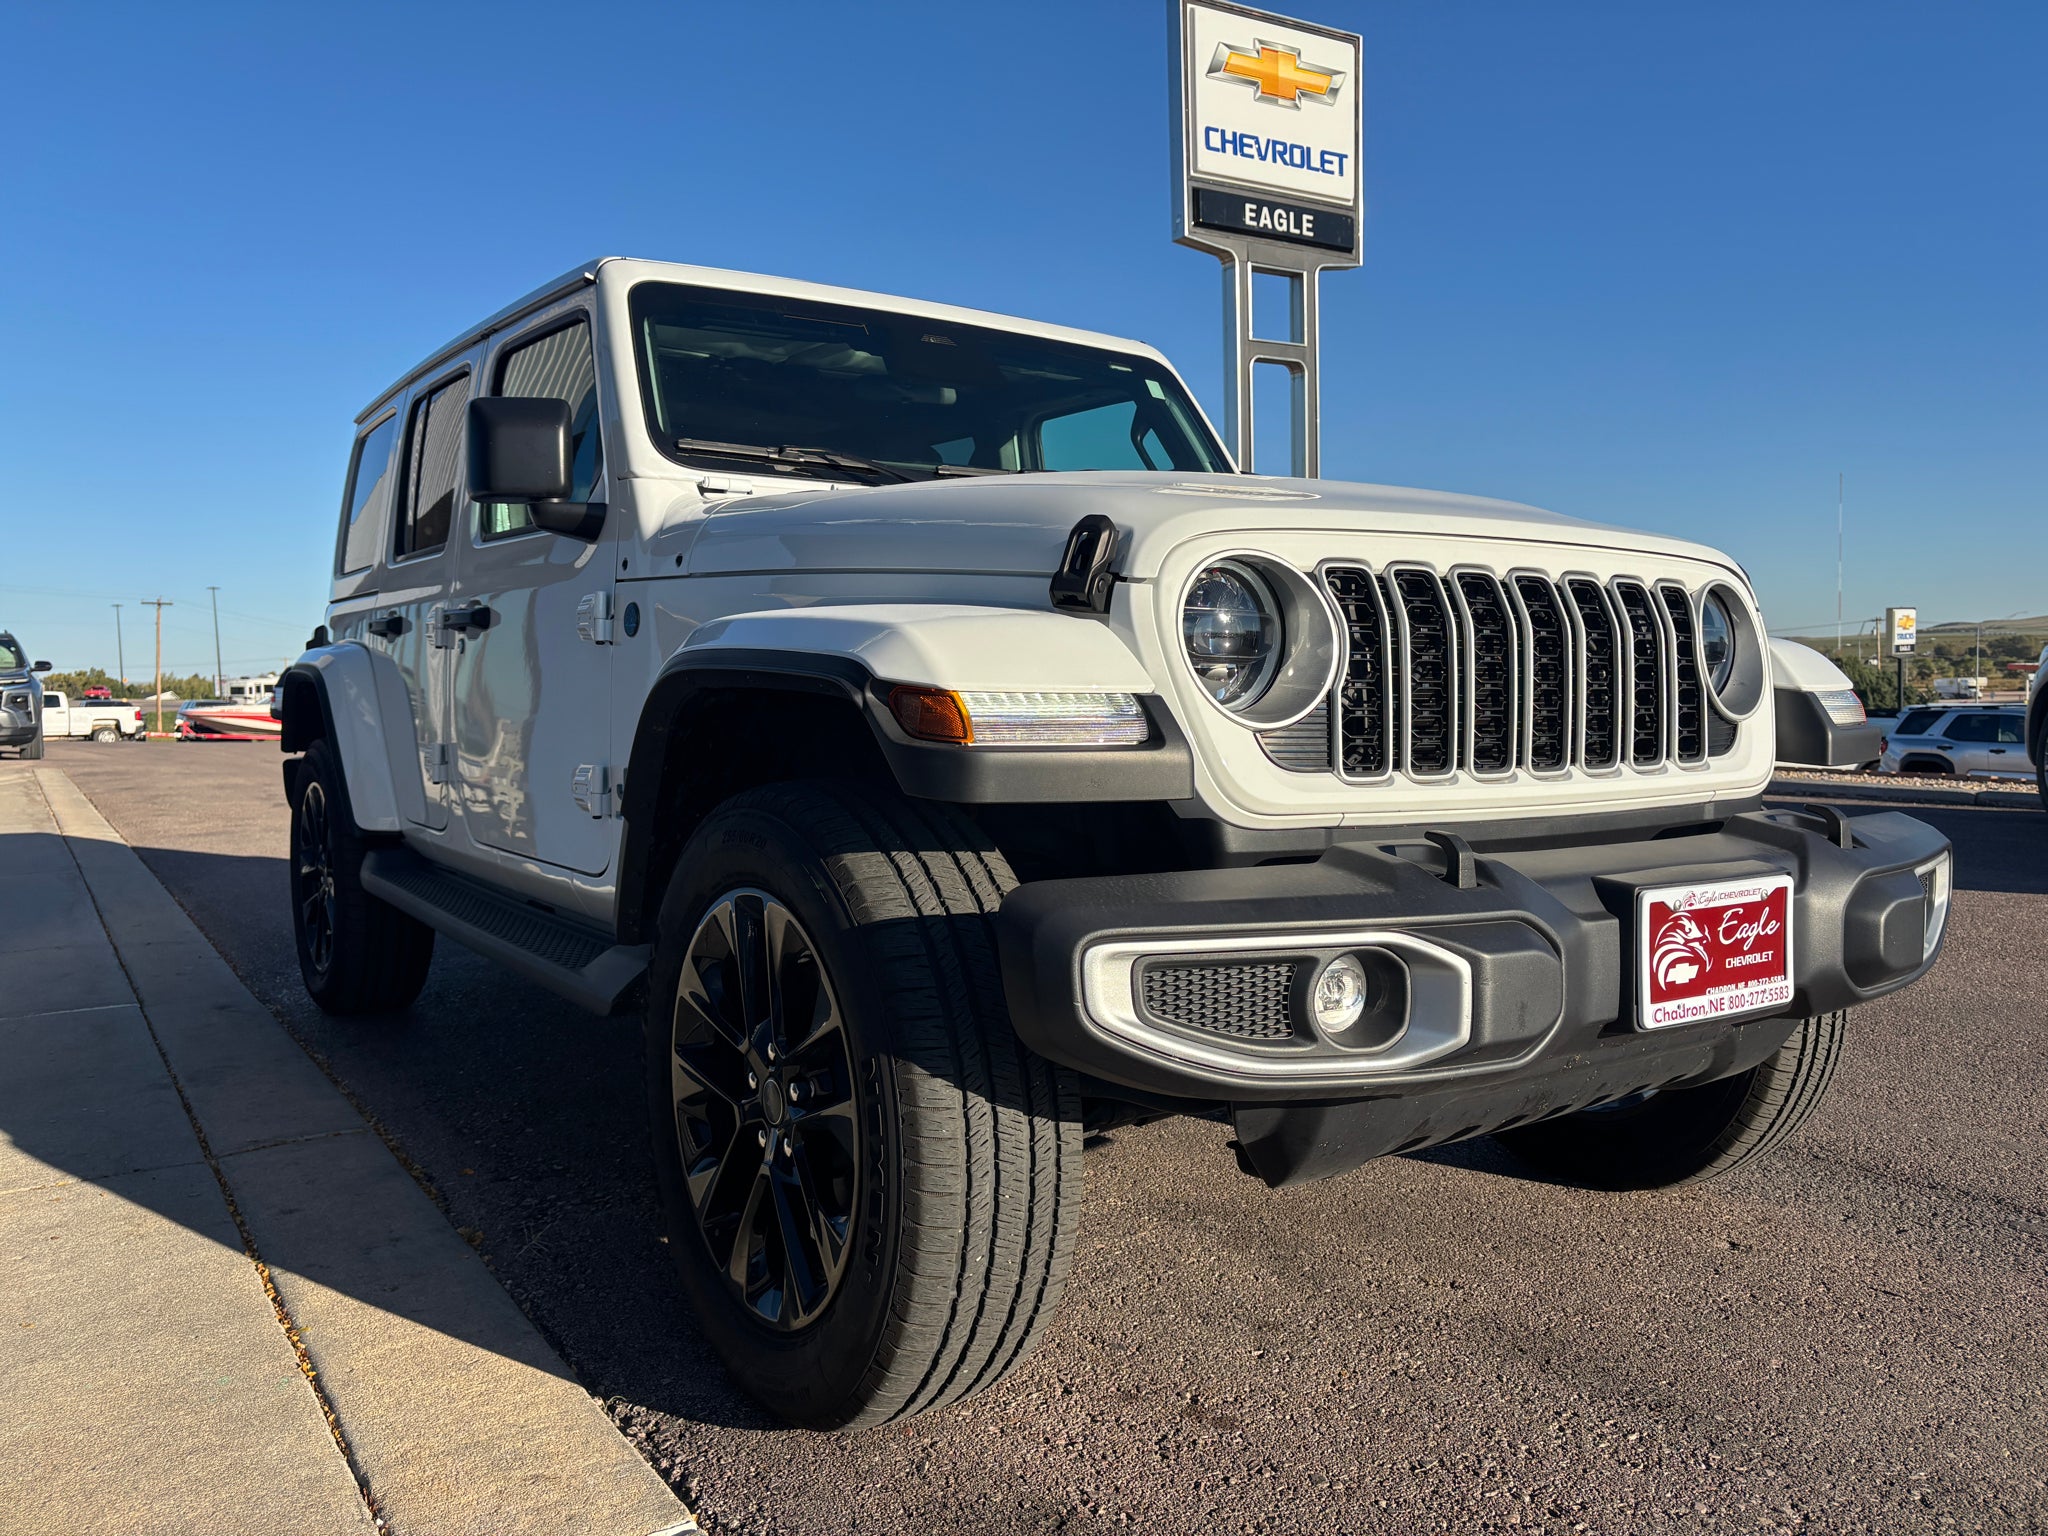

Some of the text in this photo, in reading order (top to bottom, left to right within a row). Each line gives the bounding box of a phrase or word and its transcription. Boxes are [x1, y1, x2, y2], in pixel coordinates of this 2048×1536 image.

[1204, 126, 1348, 177] CHEVROLET
[1244, 202, 1315, 237] EAGLE
[1698, 888, 1762, 906] Eagle CHEVROLET
[1717, 906, 1780, 951] Eagle
[1725, 951, 1774, 968] CHEVROLET
[1728, 986, 1789, 1009] 800-272-5583
